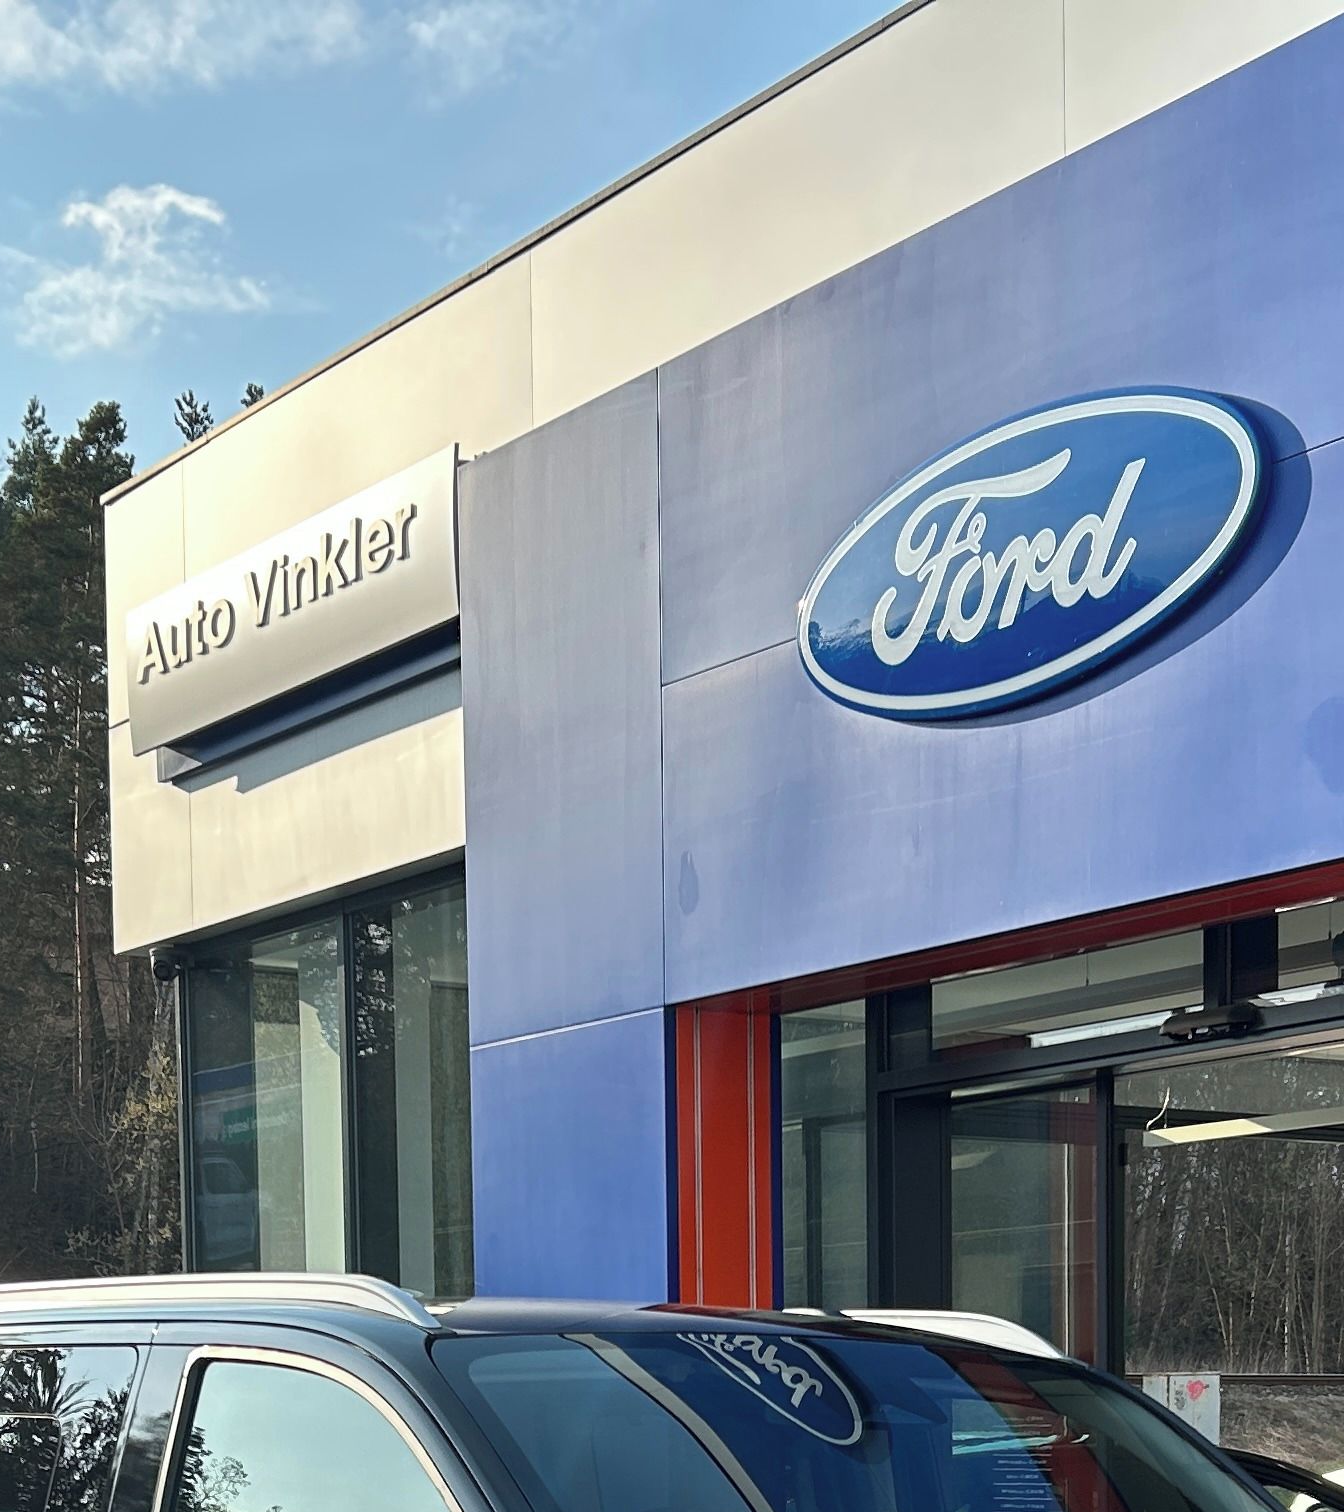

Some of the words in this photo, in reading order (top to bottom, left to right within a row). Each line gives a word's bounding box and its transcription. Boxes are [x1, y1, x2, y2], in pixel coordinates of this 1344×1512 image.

[136, 599, 236, 686] Auto
[244, 503, 418, 628] Vinkler
[871, 447, 1147, 667] Ford
